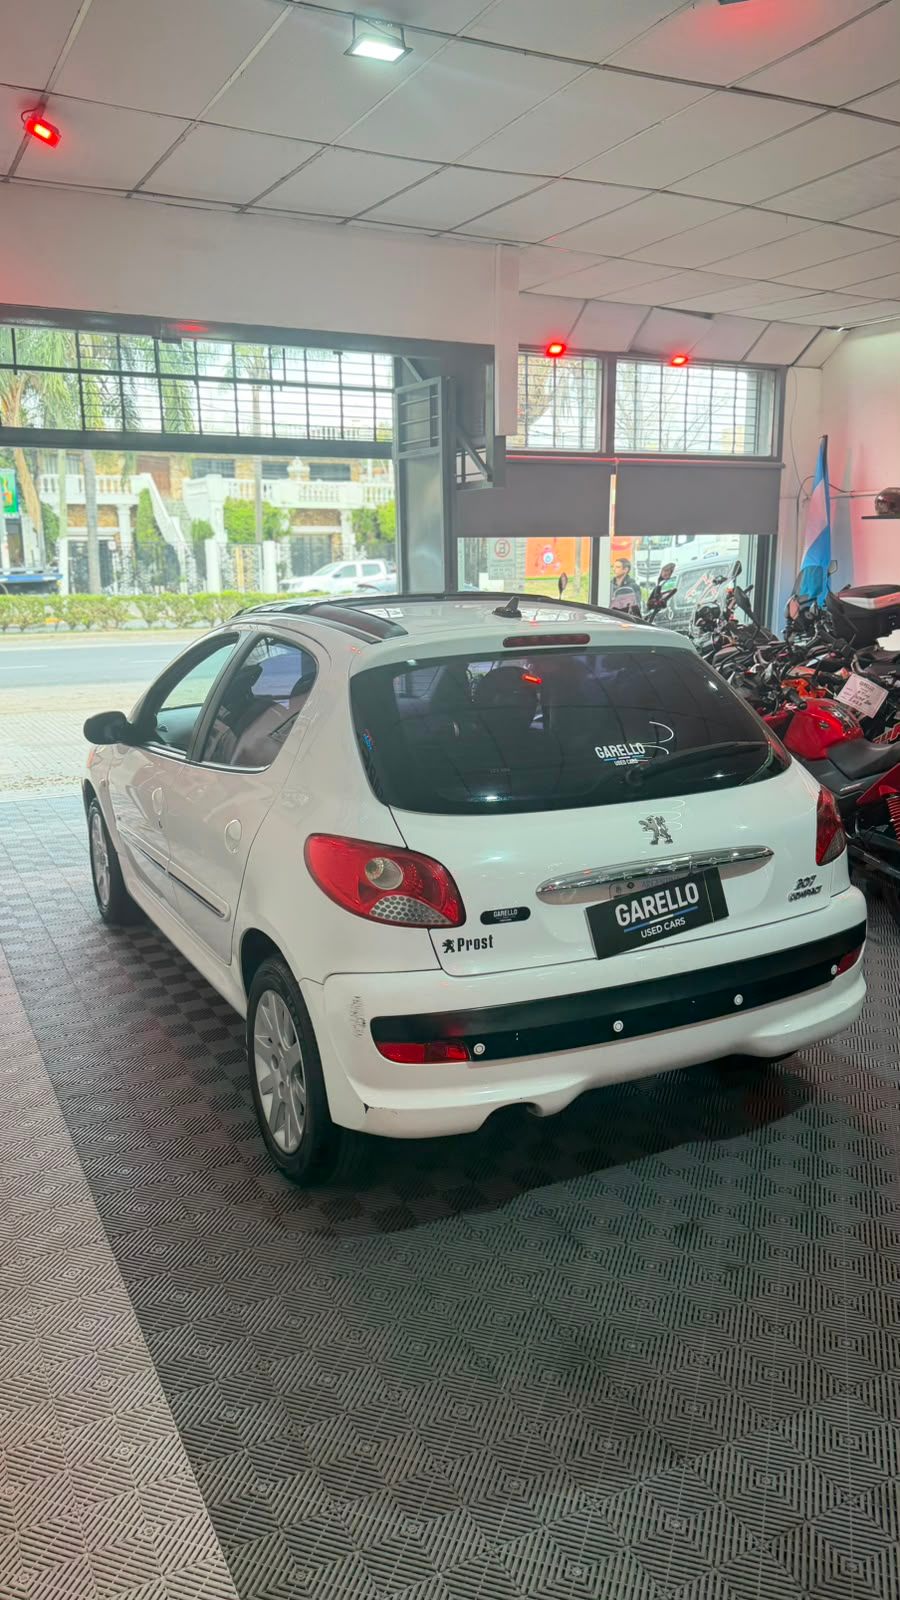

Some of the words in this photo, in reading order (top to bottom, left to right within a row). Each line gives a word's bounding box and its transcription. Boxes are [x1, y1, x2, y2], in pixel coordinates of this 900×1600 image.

[594, 742, 646, 759] GARELLO
[794, 874, 817, 891] 207
[493, 908, 518, 918] GARELLO
[615, 882, 700, 927] GARELLO
[640, 925, 663, 938] USED
[663, 917, 686, 931] CARS
[456, 934, 494, 952] Prost
